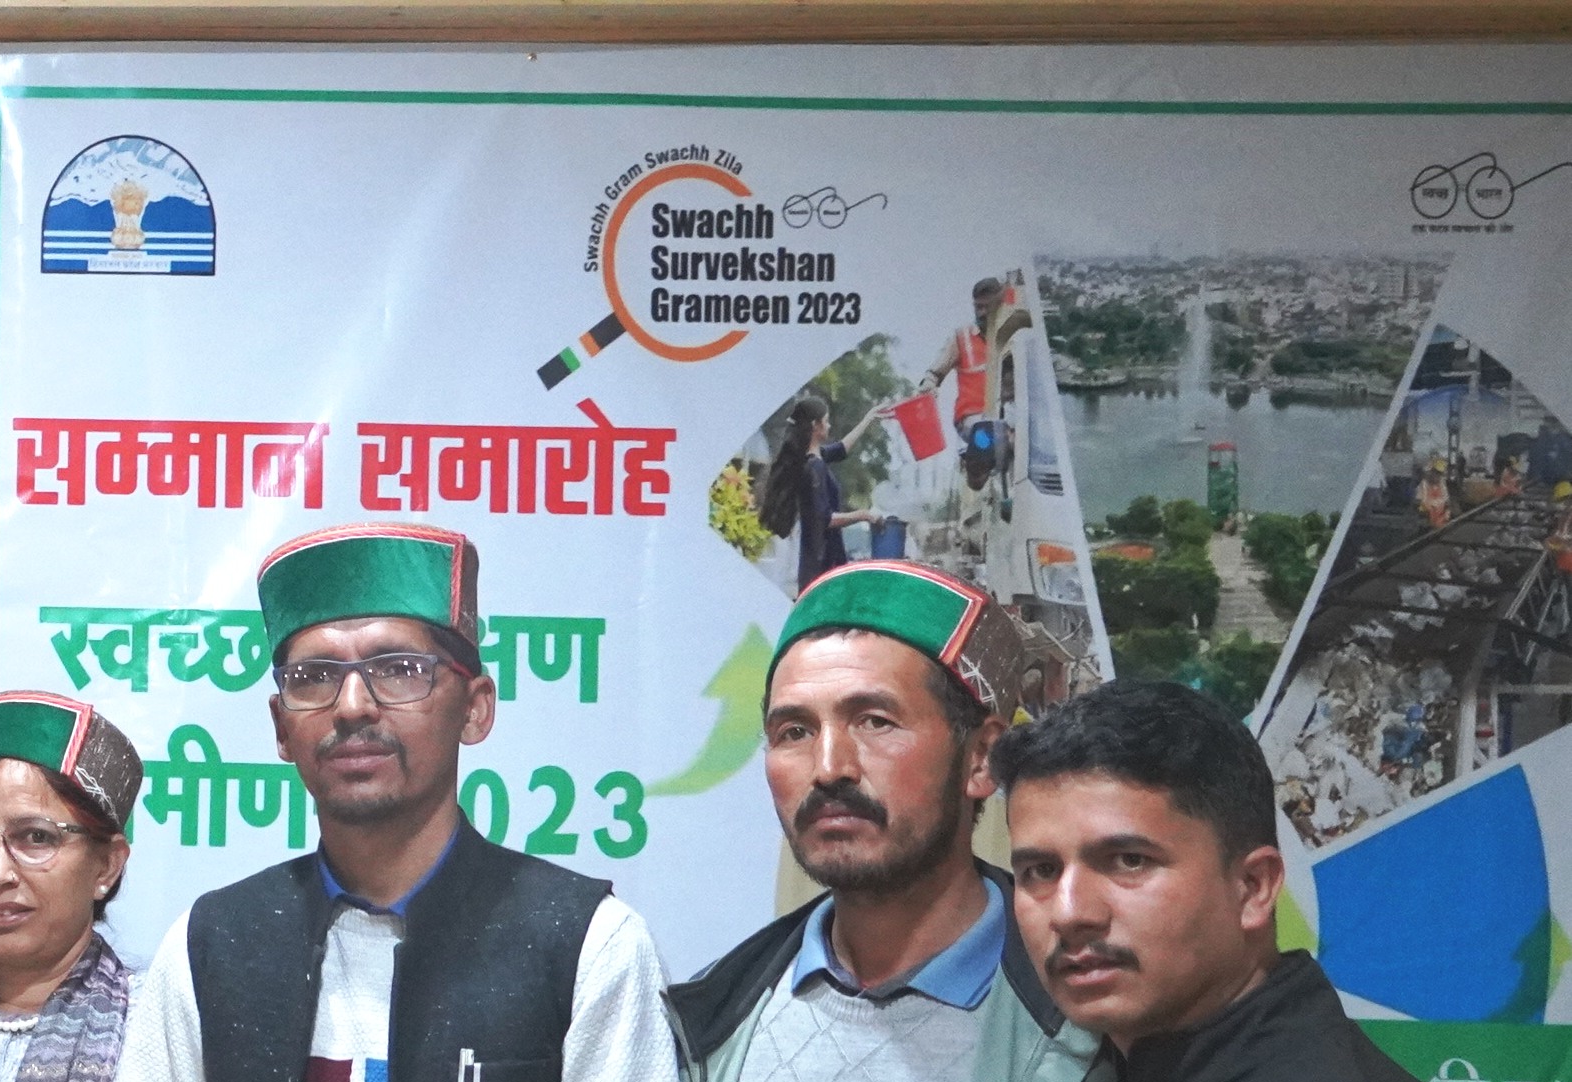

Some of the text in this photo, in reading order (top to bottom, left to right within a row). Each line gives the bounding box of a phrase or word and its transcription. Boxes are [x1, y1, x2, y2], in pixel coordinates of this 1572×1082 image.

[584, 144, 743, 272] Swachh Gram Swachh Zila
[652, 203, 774, 239] Swachh
[651, 245, 835, 282] Survekshan
[651, 288, 861, 325] Grameen 2023
[13, 397, 677, 517] सम्मान समारोह
[39, 606, 273, 692] स्वच्छ
[458, 765, 648, 859] 023
